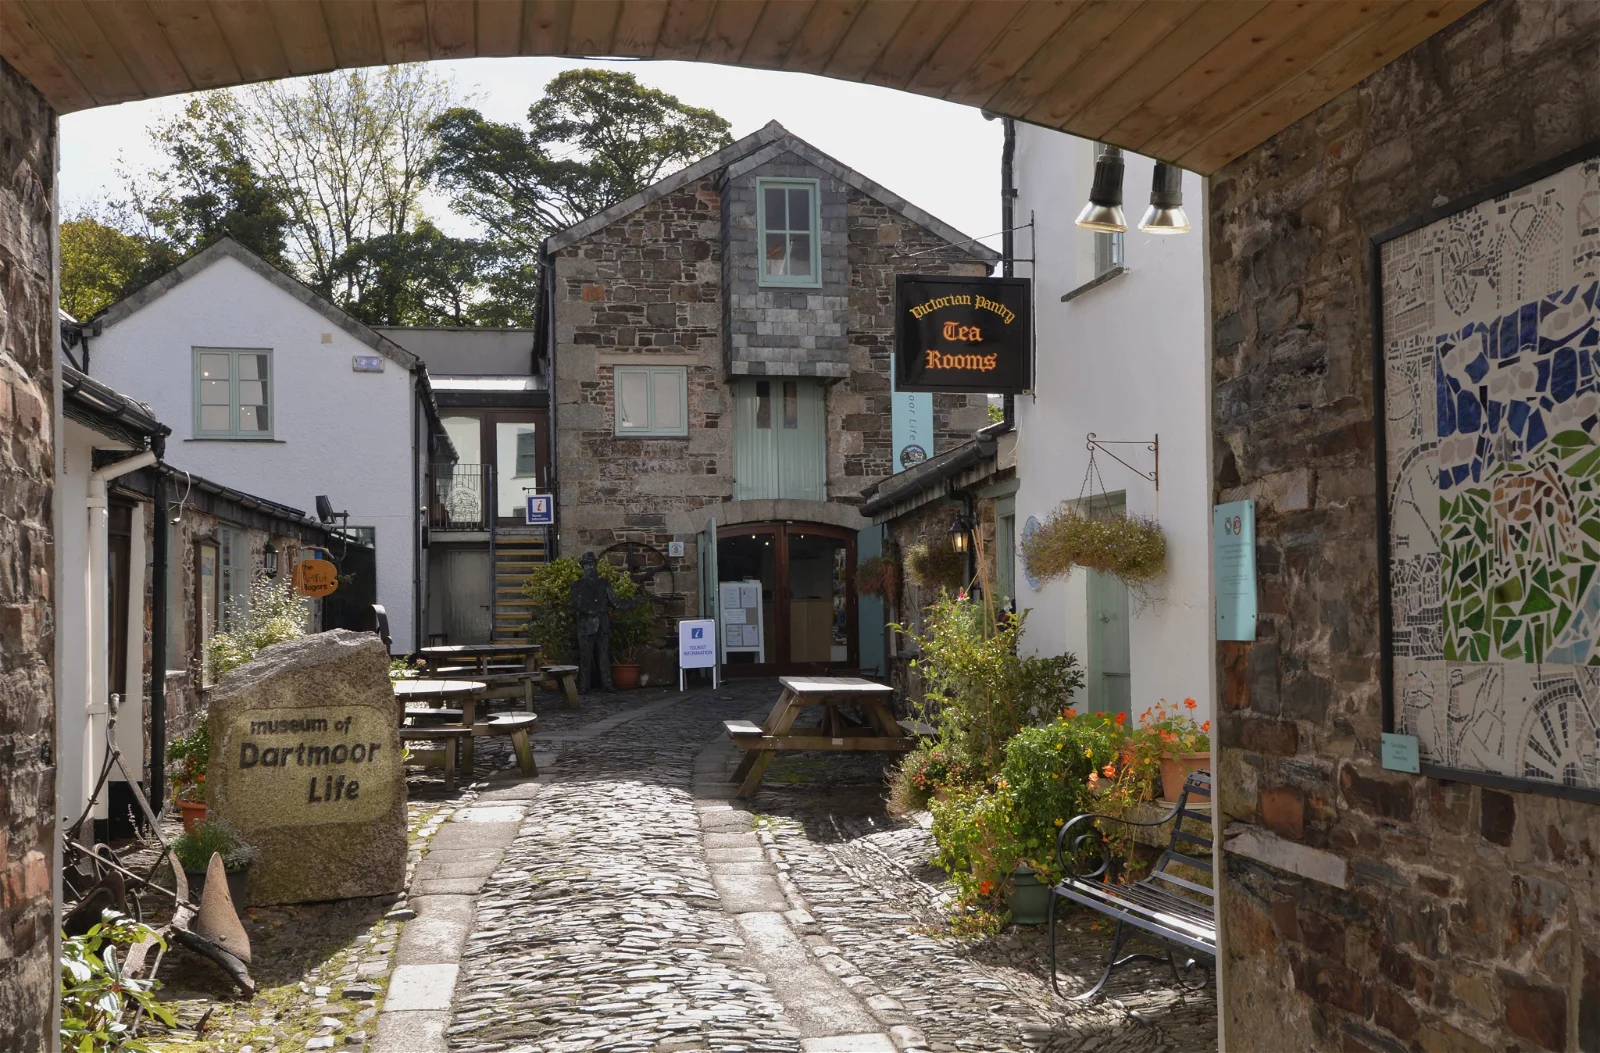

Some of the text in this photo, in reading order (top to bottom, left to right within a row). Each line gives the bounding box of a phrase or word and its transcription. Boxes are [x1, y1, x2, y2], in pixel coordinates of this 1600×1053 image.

[909, 294, 1016, 325] Victorian Pantry
[942, 321, 983, 342] Tea
[925, 349, 998, 372] Rooms
[908, 418, 918, 441] Life
[250, 715, 353, 735] museum of
[239, 741, 382, 769] Dartmoor
[308, 774, 360, 803] Life
